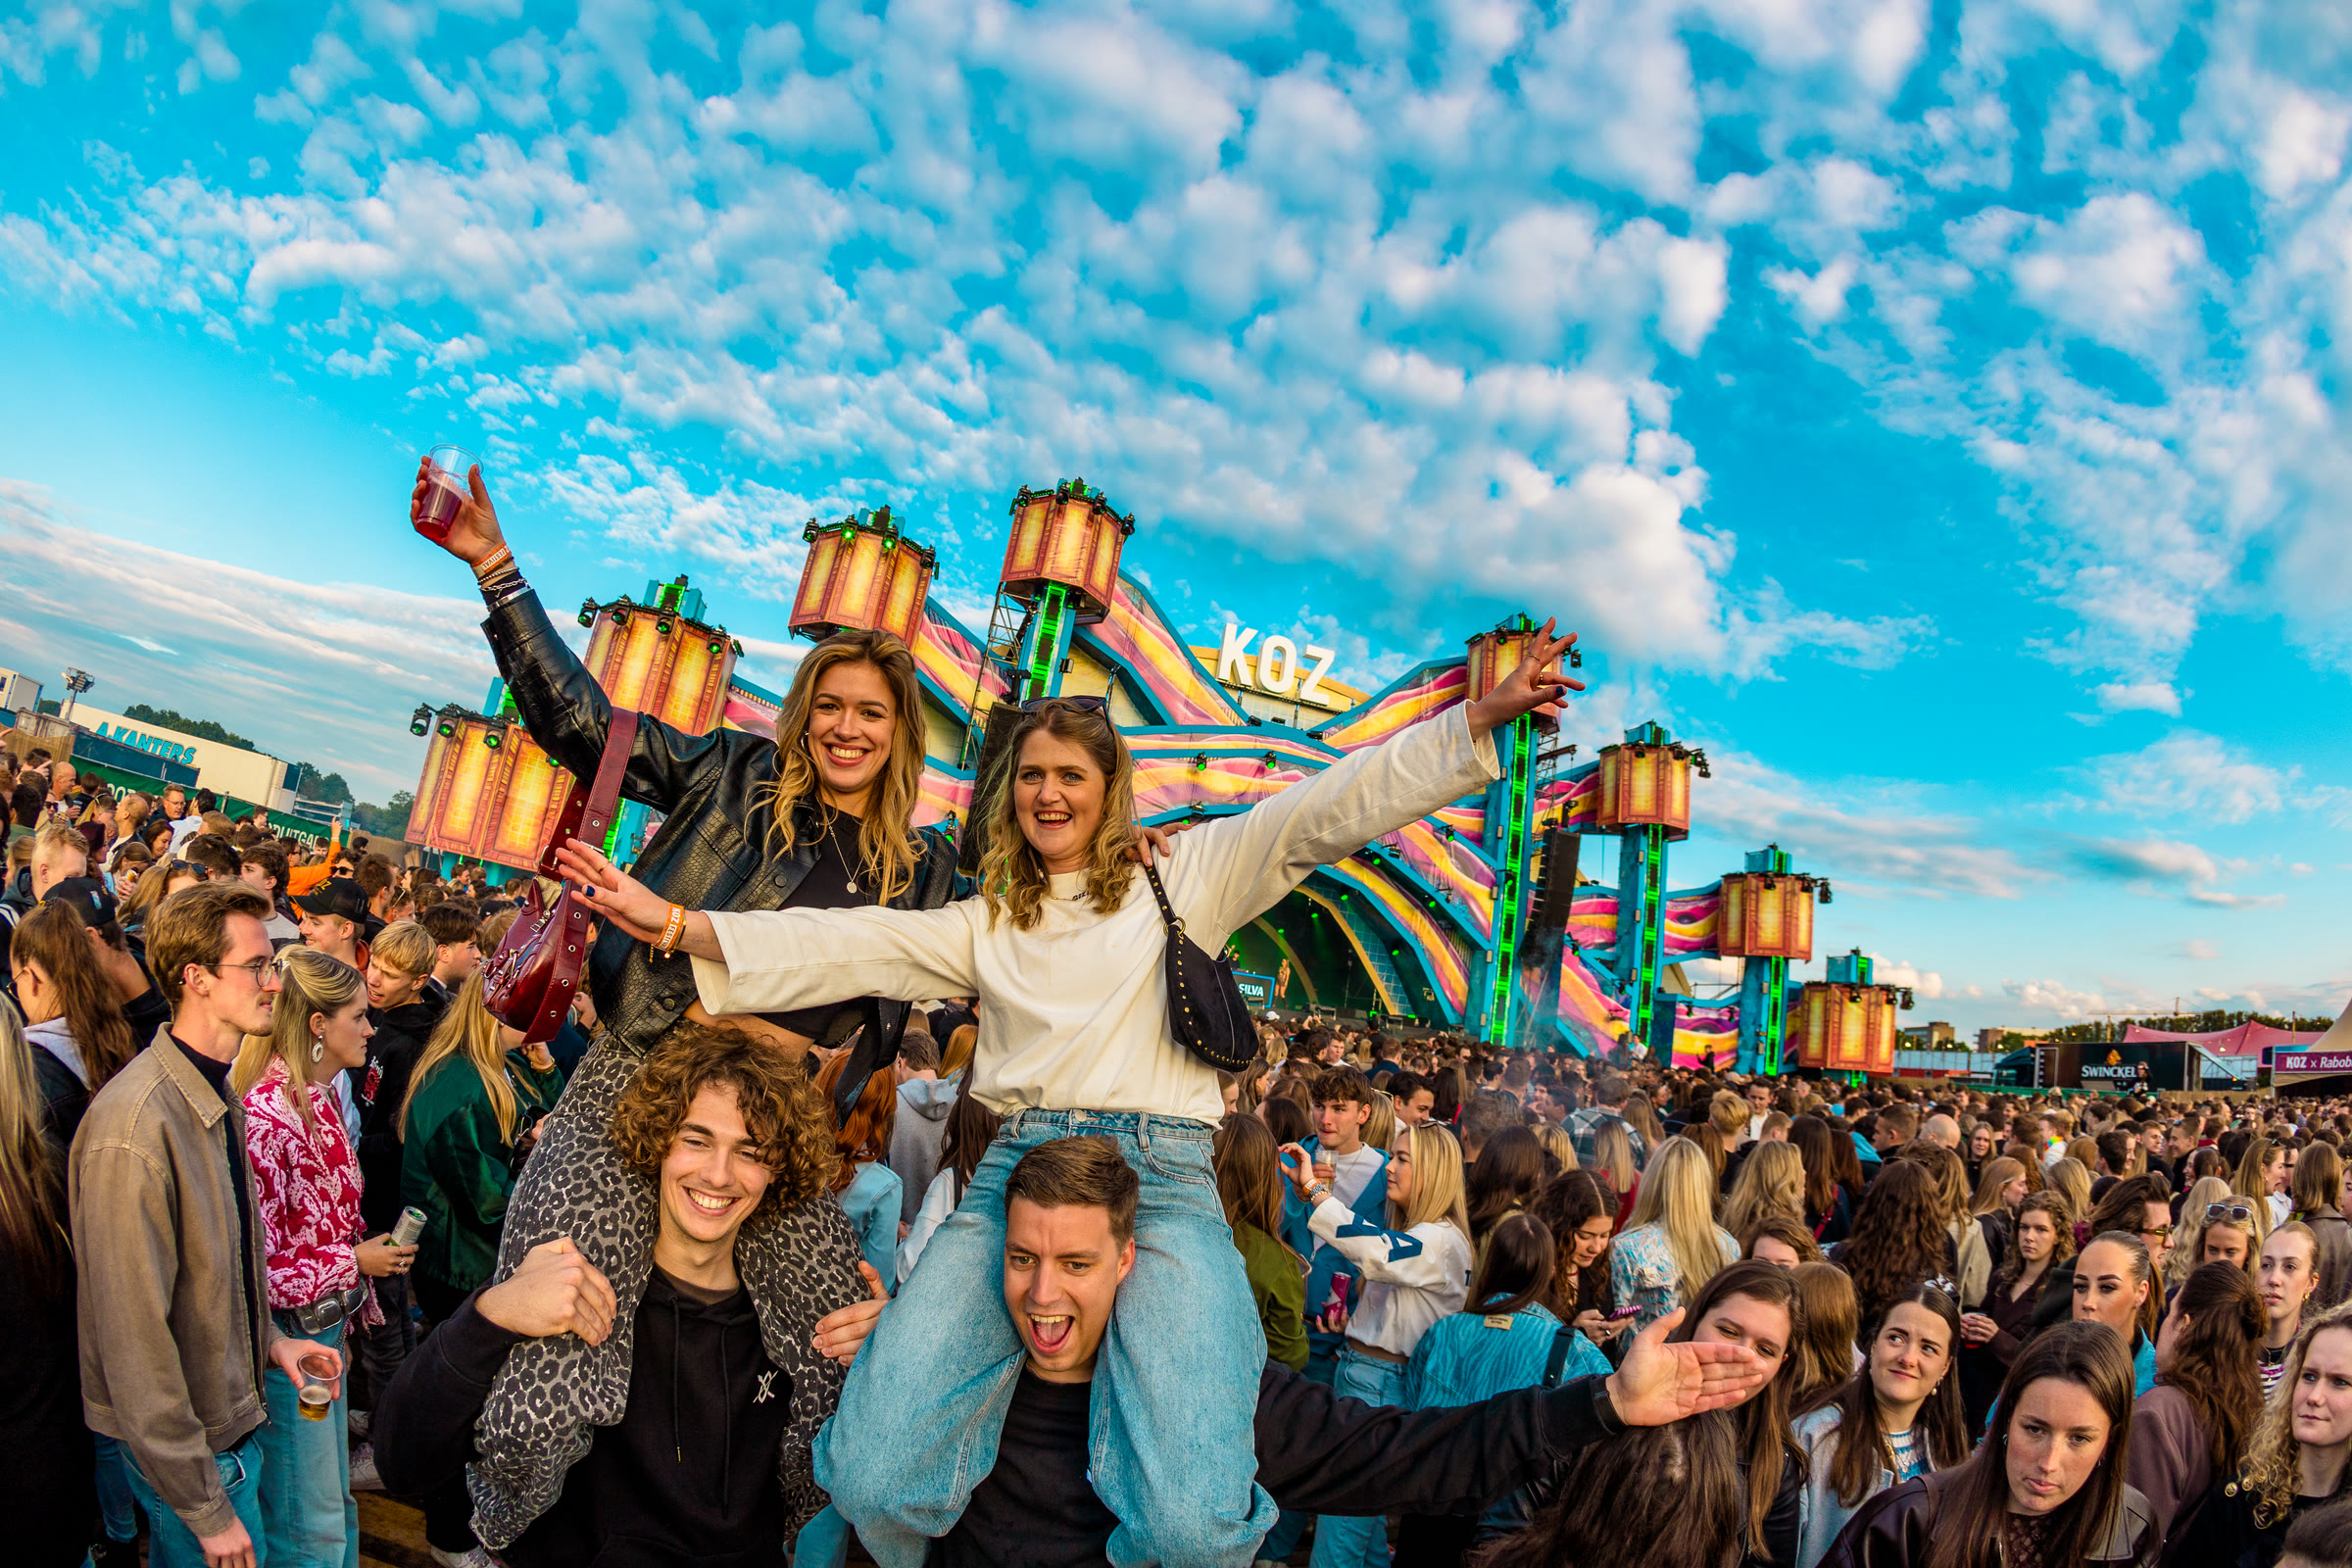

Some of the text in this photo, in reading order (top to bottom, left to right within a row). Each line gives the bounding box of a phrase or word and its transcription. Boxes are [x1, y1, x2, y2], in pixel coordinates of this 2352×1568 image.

[1215, 622, 1335, 707] KOZ
[670, 906, 681, 924] KOZ
[1238, 982, 1264, 997] SILVA
[2286, 1055, 2308, 1069] KOZ
[2320, 1054, 2352, 1069] Rabob
[2081, 1064, 2137, 1079] SWINCKEL
